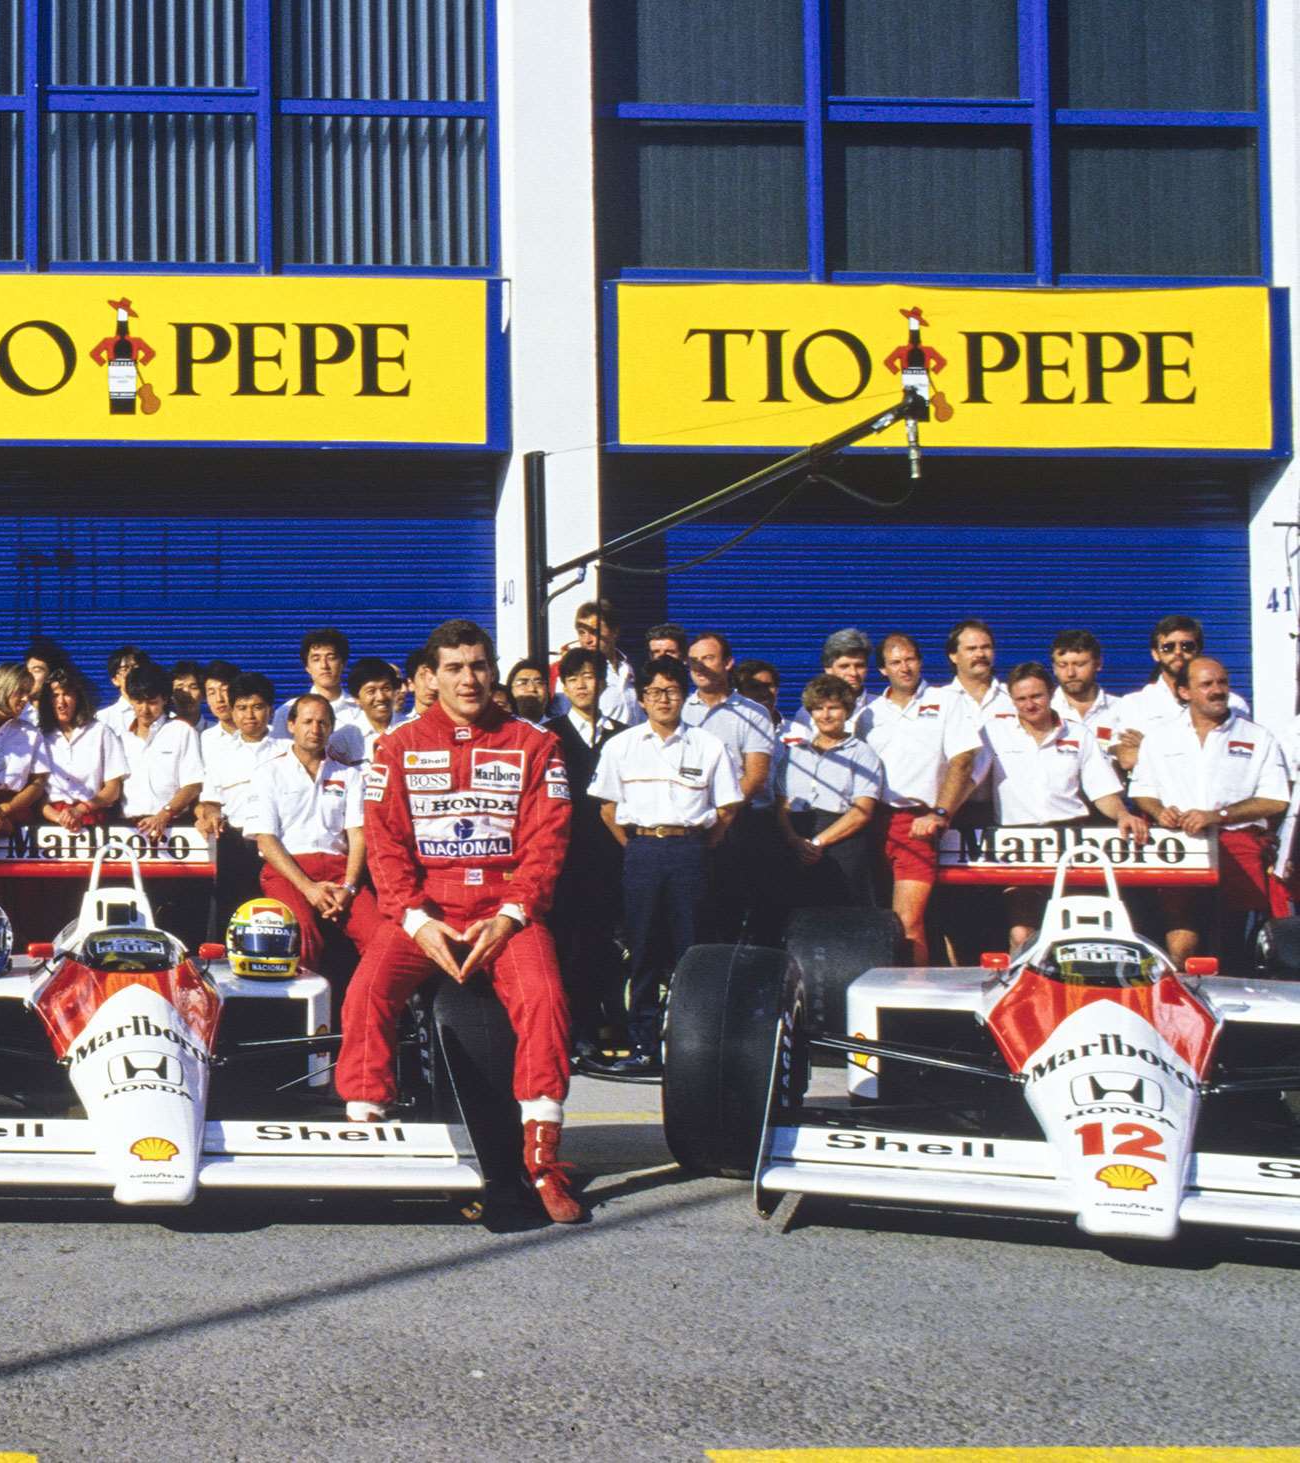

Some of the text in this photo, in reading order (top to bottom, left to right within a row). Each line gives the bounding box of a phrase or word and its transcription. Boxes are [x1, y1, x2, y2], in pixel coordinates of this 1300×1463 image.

[168, 322, 411, 397] PEPE
[684, 329, 1197, 405] TIO PEPE
[1266, 586, 1291, 613] 41
[420, 757, 448, 765] Shell
[409, 775, 449, 788] BOSS
[474, 766, 521, 782] Marlboro
[431, 797, 516, 812] HONDA
[6, 825, 190, 861] Marlboro
[424, 841, 508, 857] NACIONAL
[957, 827, 1186, 865] Marlboro
[244, 926, 290, 936] HONDA
[76, 1015, 207, 1065] Marlboro
[1032, 1033, 1196, 1091] Marlboro
[104, 1084, 195, 1102] HONDA
[1064, 1106, 1178, 1130] HONDA
[256, 1125, 406, 1142] Shell
[826, 1132, 995, 1159] Shell
[1074, 1122, 1167, 1162] 12
